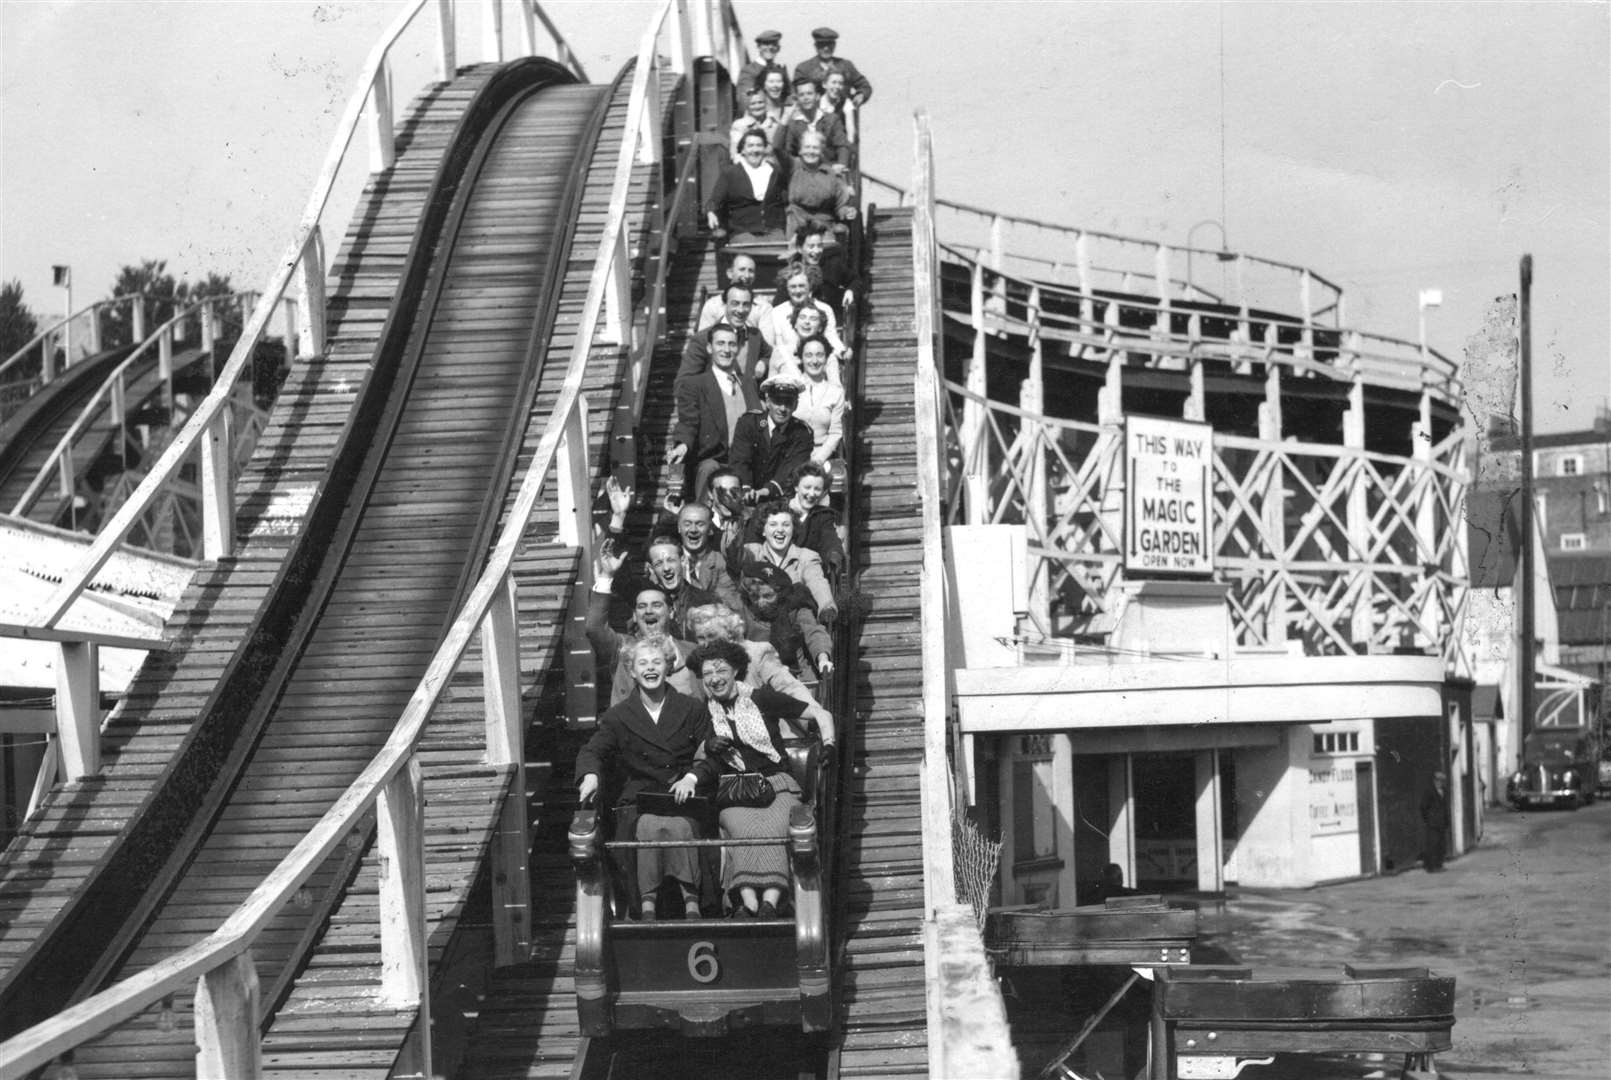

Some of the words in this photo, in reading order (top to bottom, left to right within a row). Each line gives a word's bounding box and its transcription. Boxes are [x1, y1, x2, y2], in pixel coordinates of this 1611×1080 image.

[1136, 434, 1166, 455] THIS
[1174, 437, 1203, 459] WAY
[1163, 461, 1177, 472] TO
[1157, 477, 1181, 492] THE
[1142, 498, 1196, 524] MAGIC
[1140, 529, 1200, 554] GARDEN
[1143, 555, 1168, 567] OPEN
[1174, 557, 1196, 568] NOW
[687, 941, 719, 983] 6
